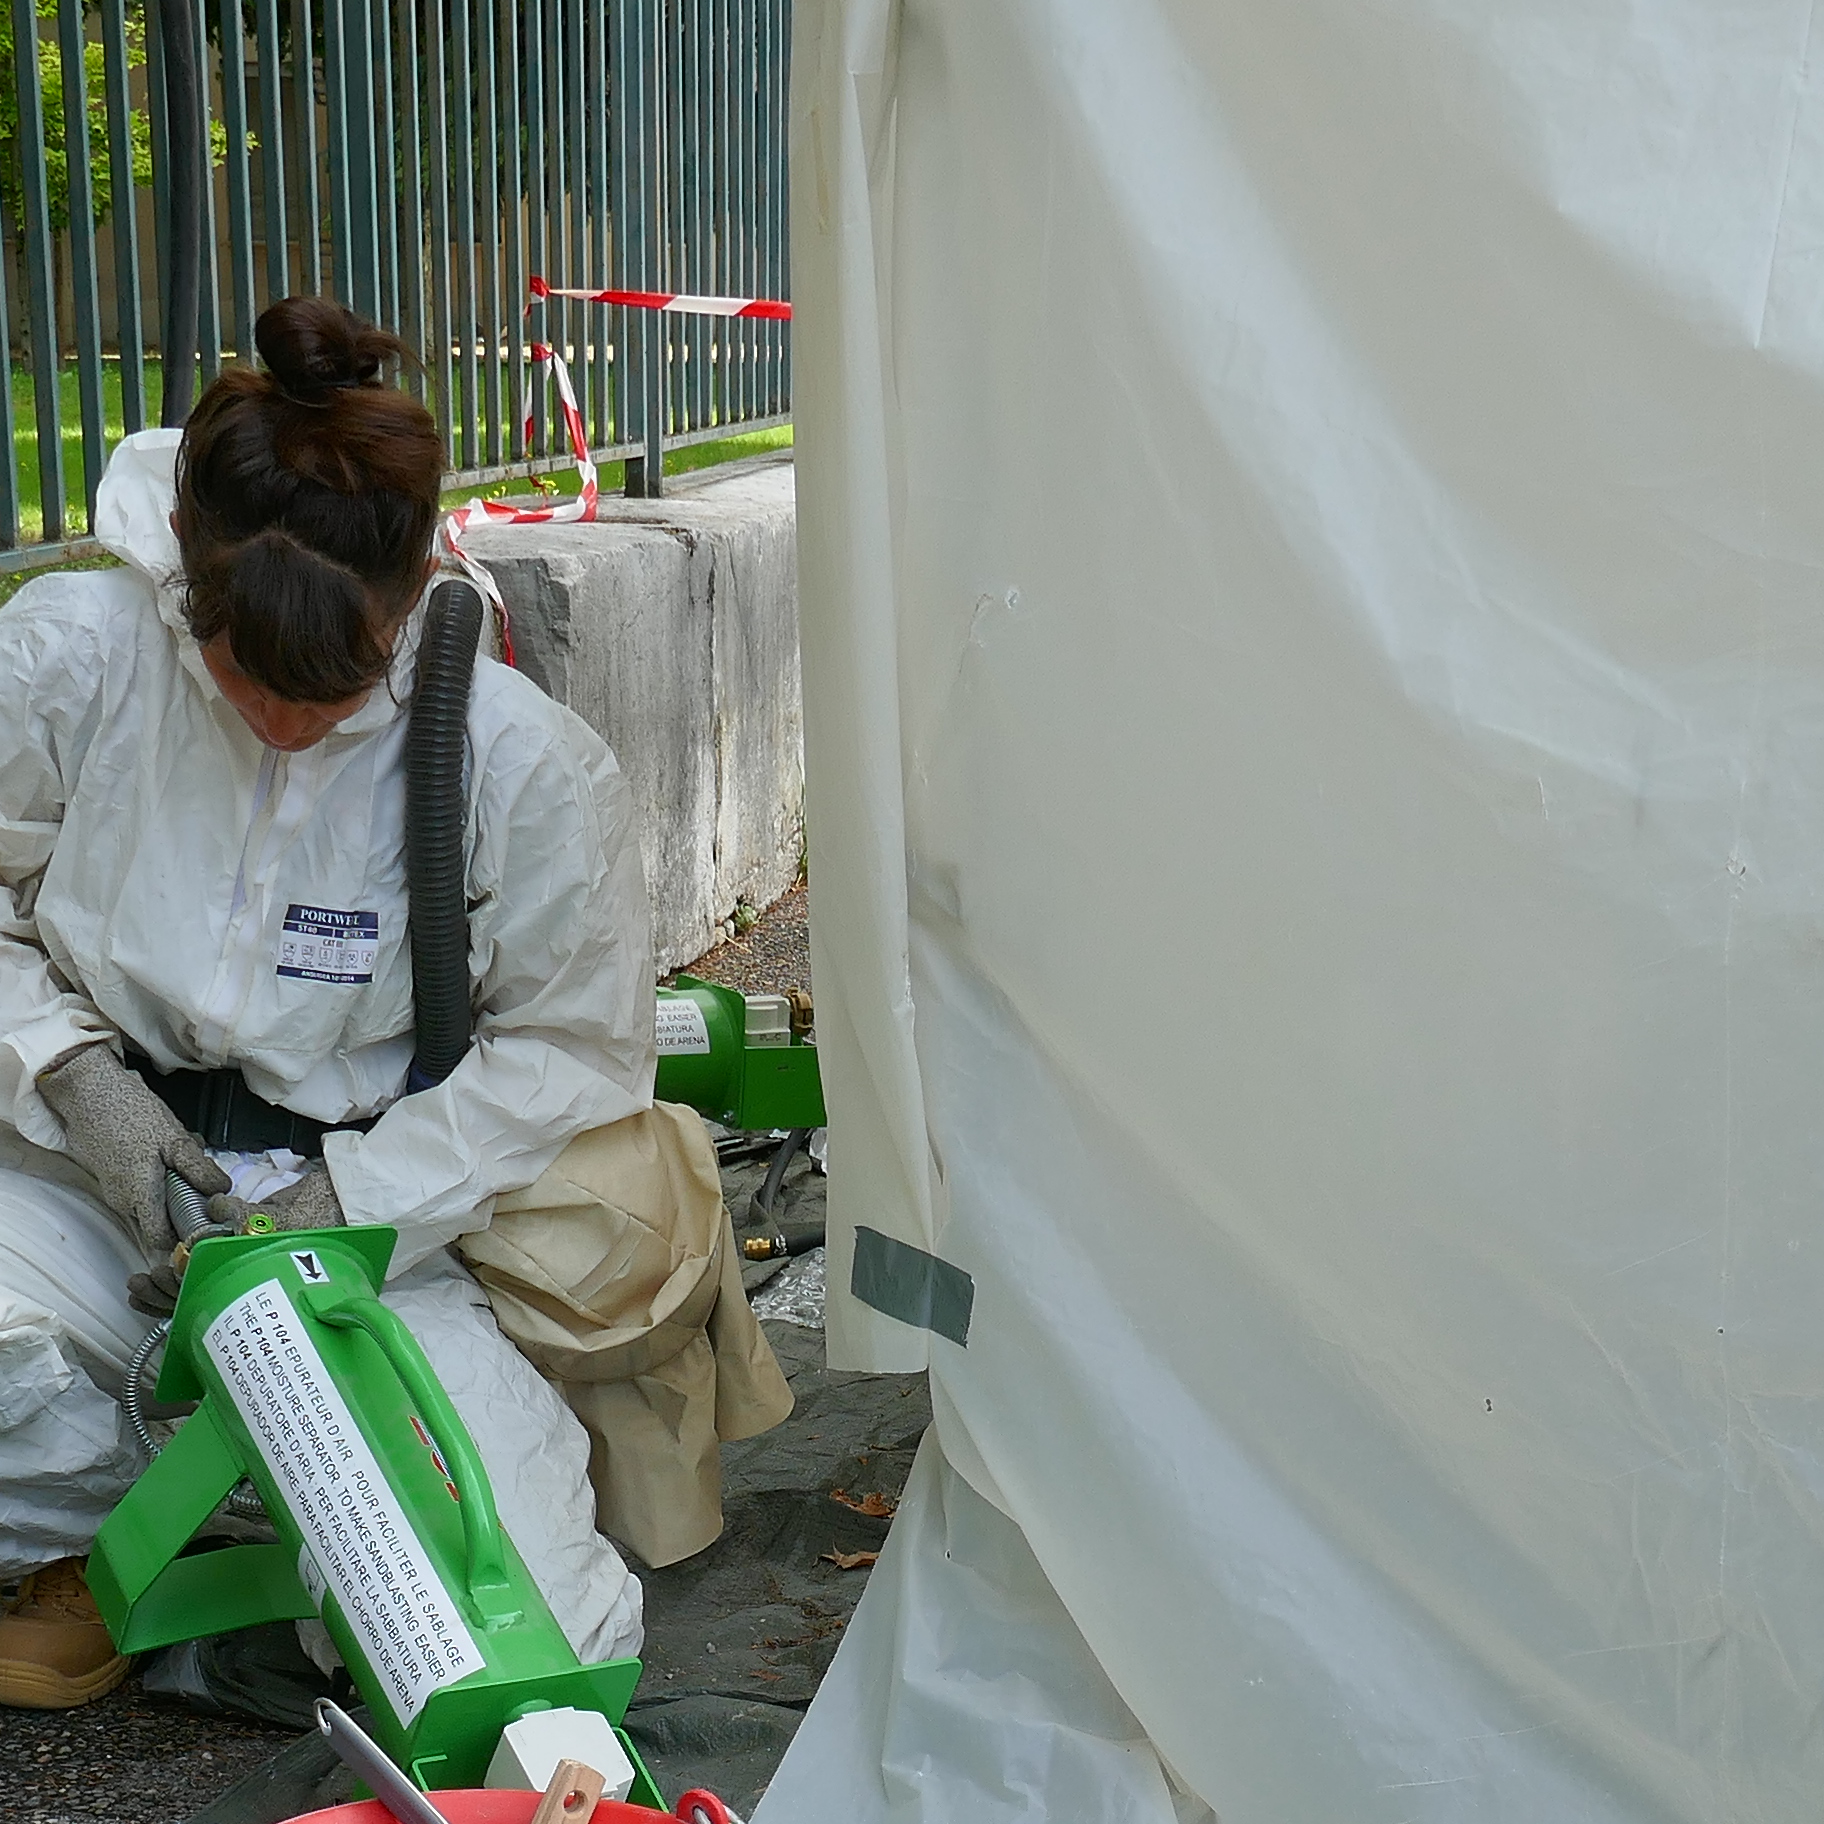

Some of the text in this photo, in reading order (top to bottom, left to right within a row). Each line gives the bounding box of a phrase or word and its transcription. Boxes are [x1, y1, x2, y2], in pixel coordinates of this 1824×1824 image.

[239, 1301, 258, 1328] THE
[250, 1326, 263, 1335] P
[256, 1336, 273, 1356] 104
[266, 1355, 305, 1415] MOISTURE
[297, 1414, 340, 1484] SEPARATOR
[229, 1328, 241, 1336] P
[235, 1339, 252, 1360] 104
[246, 1359, 295, 1440] DEPURATORE
[314, 1487, 333, 1517] PER
[328, 1514, 371, 1587] FACILITARE
[365, 1584, 379, 1605] LA
[372, 1603, 422, 1685] SABBIATURA
[255, 1291, 272, 1309] LE
[265, 1311, 278, 1320] P
[272, 1323, 291, 1344] 104
[284, 1346, 333, 1424] EPURATEUR
[351, 1470, 379, 1510] POUR
[372, 1510, 417, 1581] FACILITER
[410, 1581, 429, 1601] LE
[422, 1603, 464, 1668] SABLAGE
[337, 1486, 352, 1506] TO
[212, 1329, 221, 1347] EL
[219, 1345, 229, 1353] P
[224, 1355, 239, 1375] 104
[234, 1373, 278, 1447] DEPURADOR
[271, 1443, 285, 1464] DE
[296, 1490, 316, 1526] PARA
[311, 1521, 350, 1582] FACILITAR
[351, 1595, 383, 1650] CHORRO
[378, 1648, 394, 1670] DE
[387, 1668, 414, 1713] ARENA
[345, 1505, 372, 1542] MAKE
[364, 1540, 419, 1631] SANDBLASTING
[414, 1633, 445, 1681] EASIER
